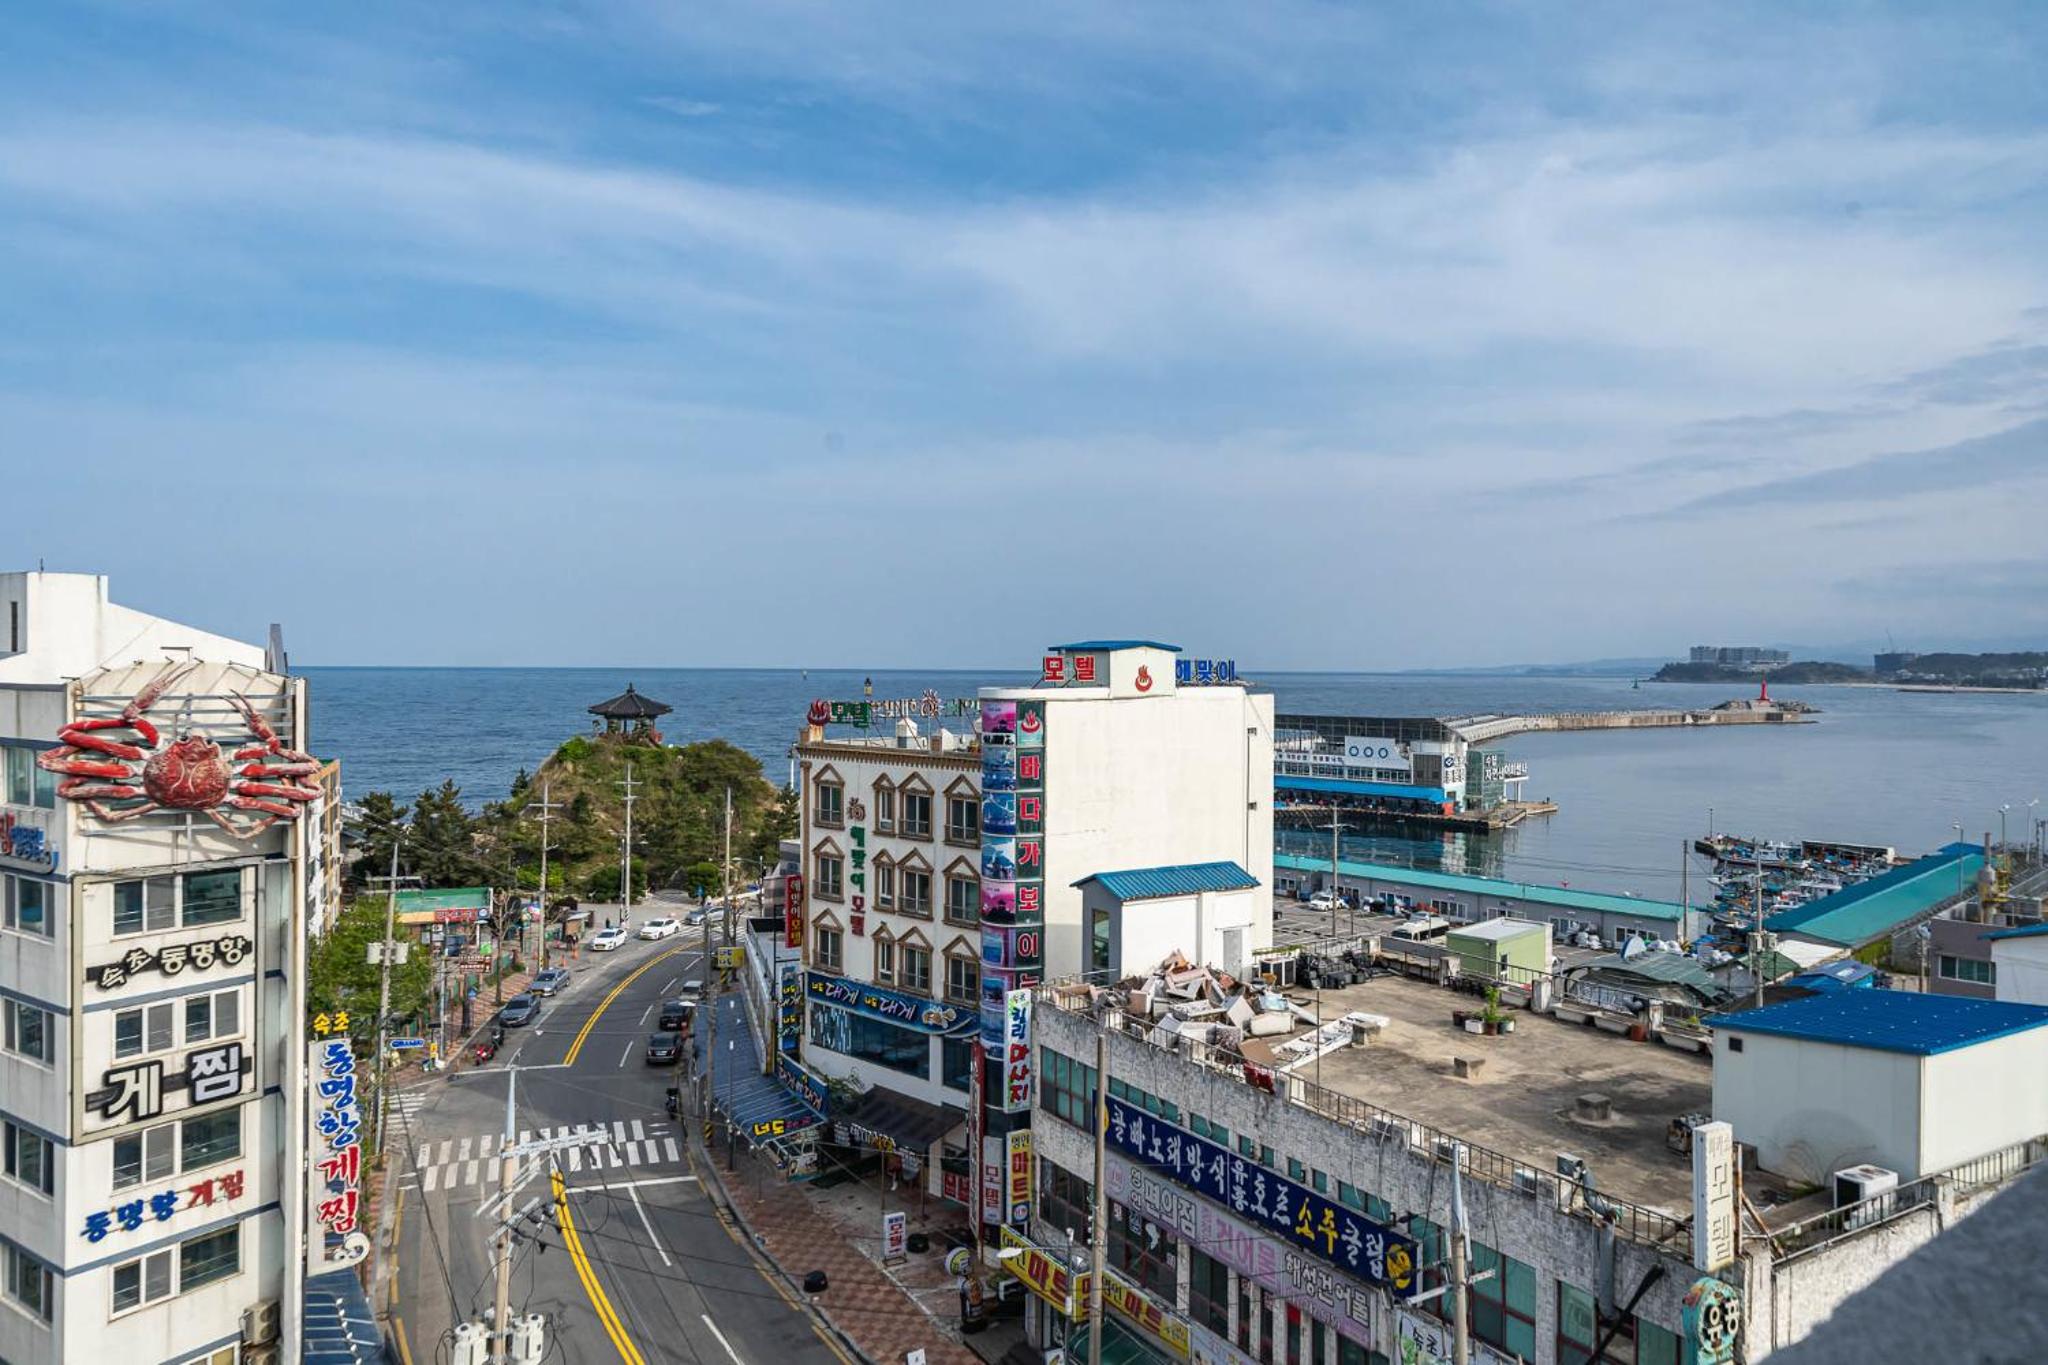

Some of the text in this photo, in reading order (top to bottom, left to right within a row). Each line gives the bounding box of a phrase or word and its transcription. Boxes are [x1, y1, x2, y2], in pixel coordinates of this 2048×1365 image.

[1045, 656, 1235, 684] 모텔 해맞이
[160, 936, 247, 975] 동명항
[313, 1011, 350, 1034] 속초
[107, 1047, 240, 1120] 게찜
[1010, 1043, 1030, 1103] 마사지
[316, 1042, 361, 1233] 동명항 게찜
[753, 1119, 786, 1136] 너도
[80, 1190, 179, 1243] 동명항
